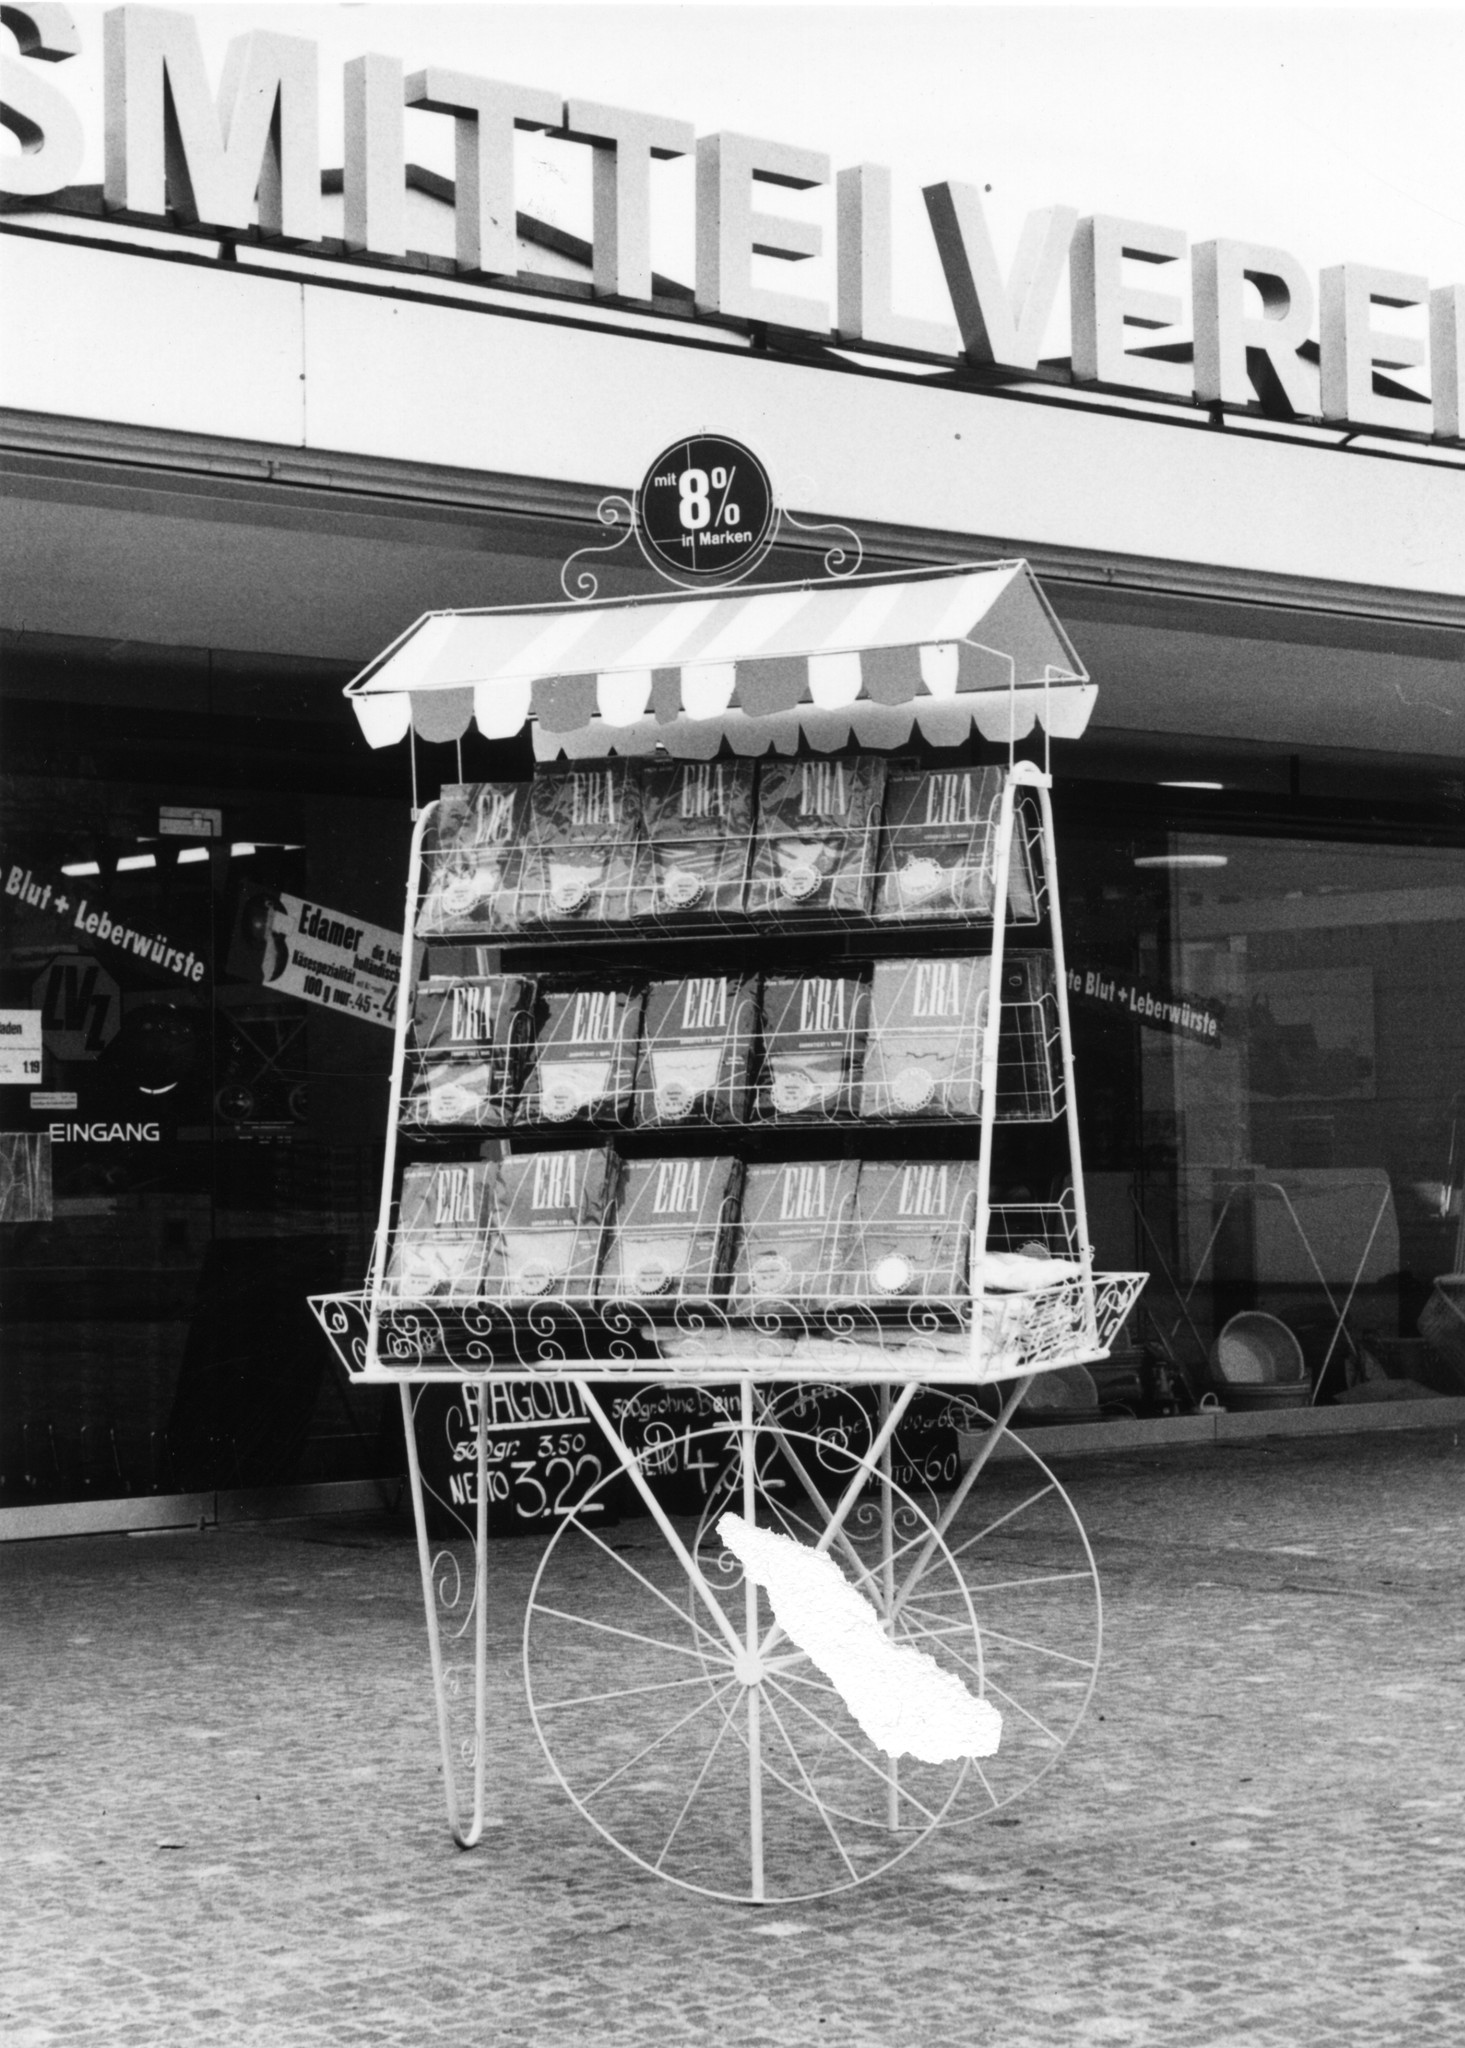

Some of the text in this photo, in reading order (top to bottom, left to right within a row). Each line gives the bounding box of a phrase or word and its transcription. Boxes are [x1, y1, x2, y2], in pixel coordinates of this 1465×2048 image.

[654, 465, 741, 530] mit 8%
[682, 530, 752, 547] in Marken
[926, 774, 972, 825] ERA
[5, 865, 52, 910] Blut
[74, 900, 205, 983] Leberwürste
[298, 903, 364, 952] Edamer
[303, 975, 323, 997] 100
[323, 986, 331, 1003] g
[333, 989, 351, 1007] nur
[451, 986, 492, 1041] ERA
[680, 977, 727, 1029] ERA
[800, 978, 845, 1031] ERA
[913, 963, 960, 1016] ERA
[1085, 971, 1115, 1002] Blut
[1130, 987, 1217, 1037] Leberwürste
[571, 991, 616, 1042] ERA
[50, 1123, 160, 1142] EINGANG
[434, 1168, 476, 1224] ERA
[531, 1155, 577, 1210] ERA
[653, 1161, 700, 1213] ERA
[780, 1166, 826, 1220] ERA
[898, 1164, 947, 1215] ERA
[537, 1433, 586, 1458] 3.50
[510, 1454, 605, 1518] 3.22
